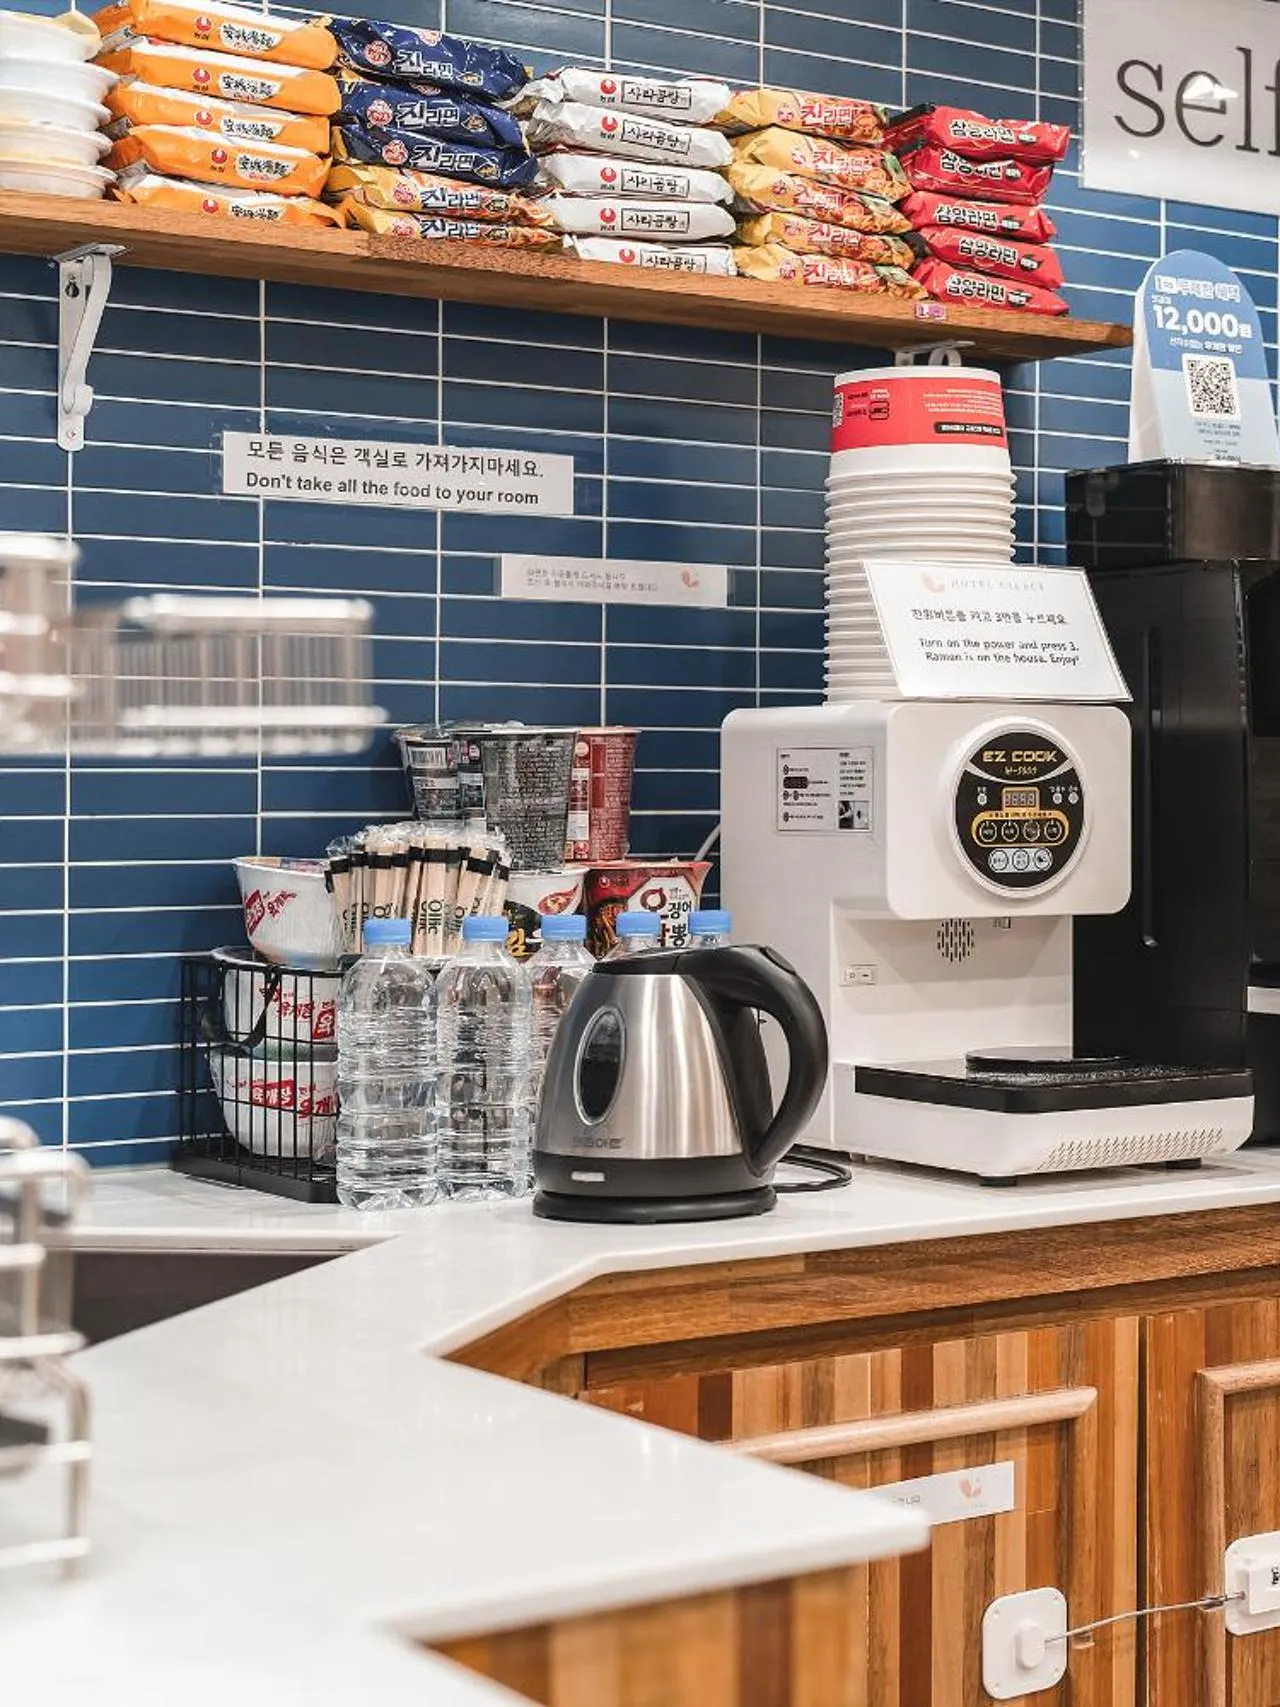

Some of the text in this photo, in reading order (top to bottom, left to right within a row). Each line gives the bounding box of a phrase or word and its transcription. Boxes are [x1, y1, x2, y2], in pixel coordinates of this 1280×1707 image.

[246, 441, 545, 478] 모든 음식은 객실로 가져가지마세요.
[246, 472, 540, 505] Don't take all the food to your room
[919, 638, 943, 648] Turn
[963, 638, 980, 649] the
[983, 640, 1014, 651] power
[1041, 641, 1067, 653] press
[982, 750, 1058, 762] EZ COOK
